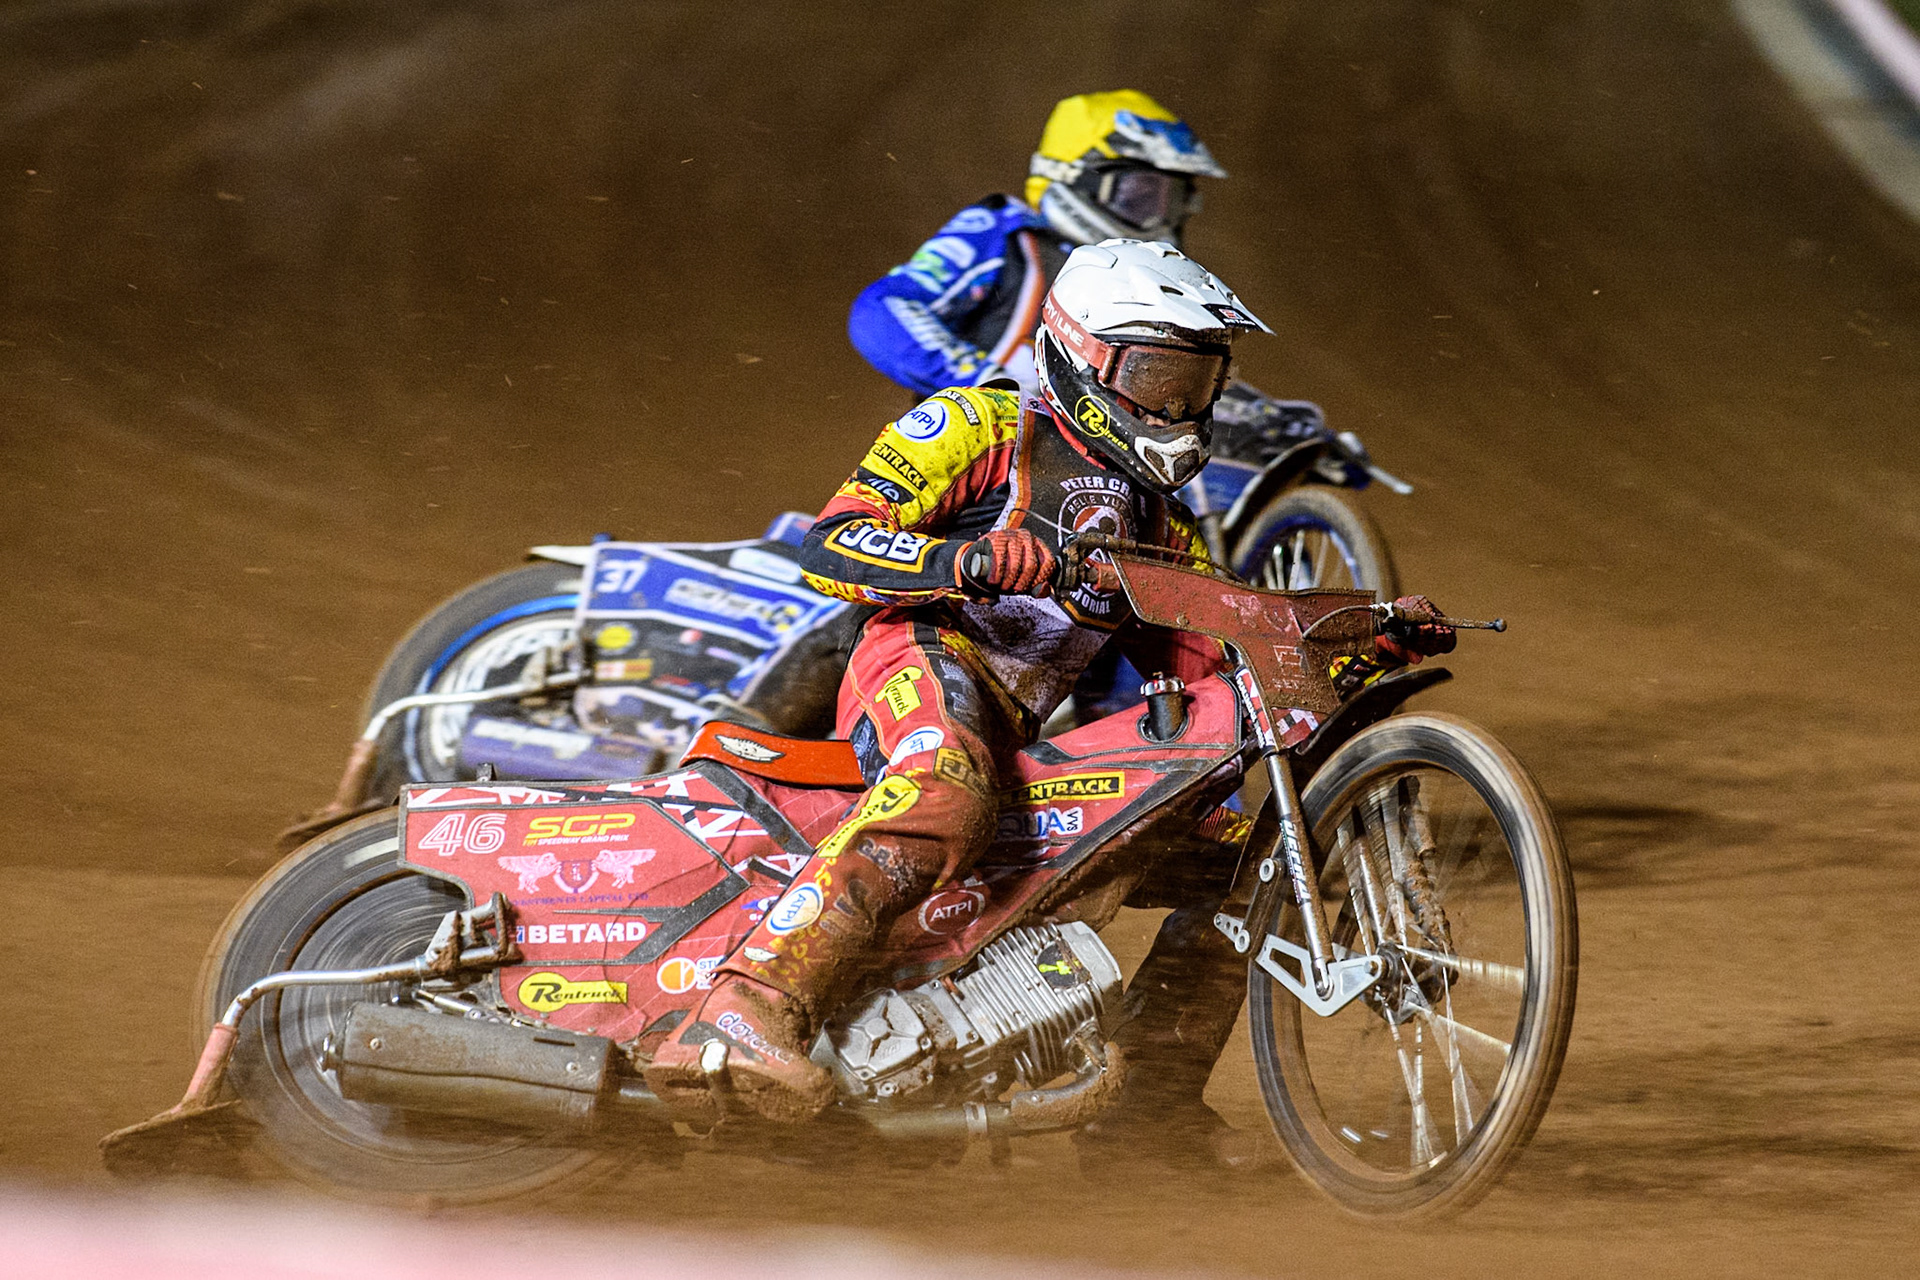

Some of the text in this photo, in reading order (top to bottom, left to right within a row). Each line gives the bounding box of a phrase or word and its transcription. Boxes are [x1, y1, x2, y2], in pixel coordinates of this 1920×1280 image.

[1060, 476, 1105, 492] PETER
[1067, 494, 1097, 515] BELLE
[838, 524, 927, 562] JCB
[597, 559, 648, 593] 37
[418, 813, 507, 856] 46
[525, 812, 636, 839] SGP
[537, 836, 580, 846] SPEEDWAY
[580, 833, 609, 844] GRAND
[609, 833, 630, 843] PRIX
[930, 899, 972, 922] ATPI
[528, 921, 647, 944] BETARD
[529, 982, 622, 1004] Rentruck
